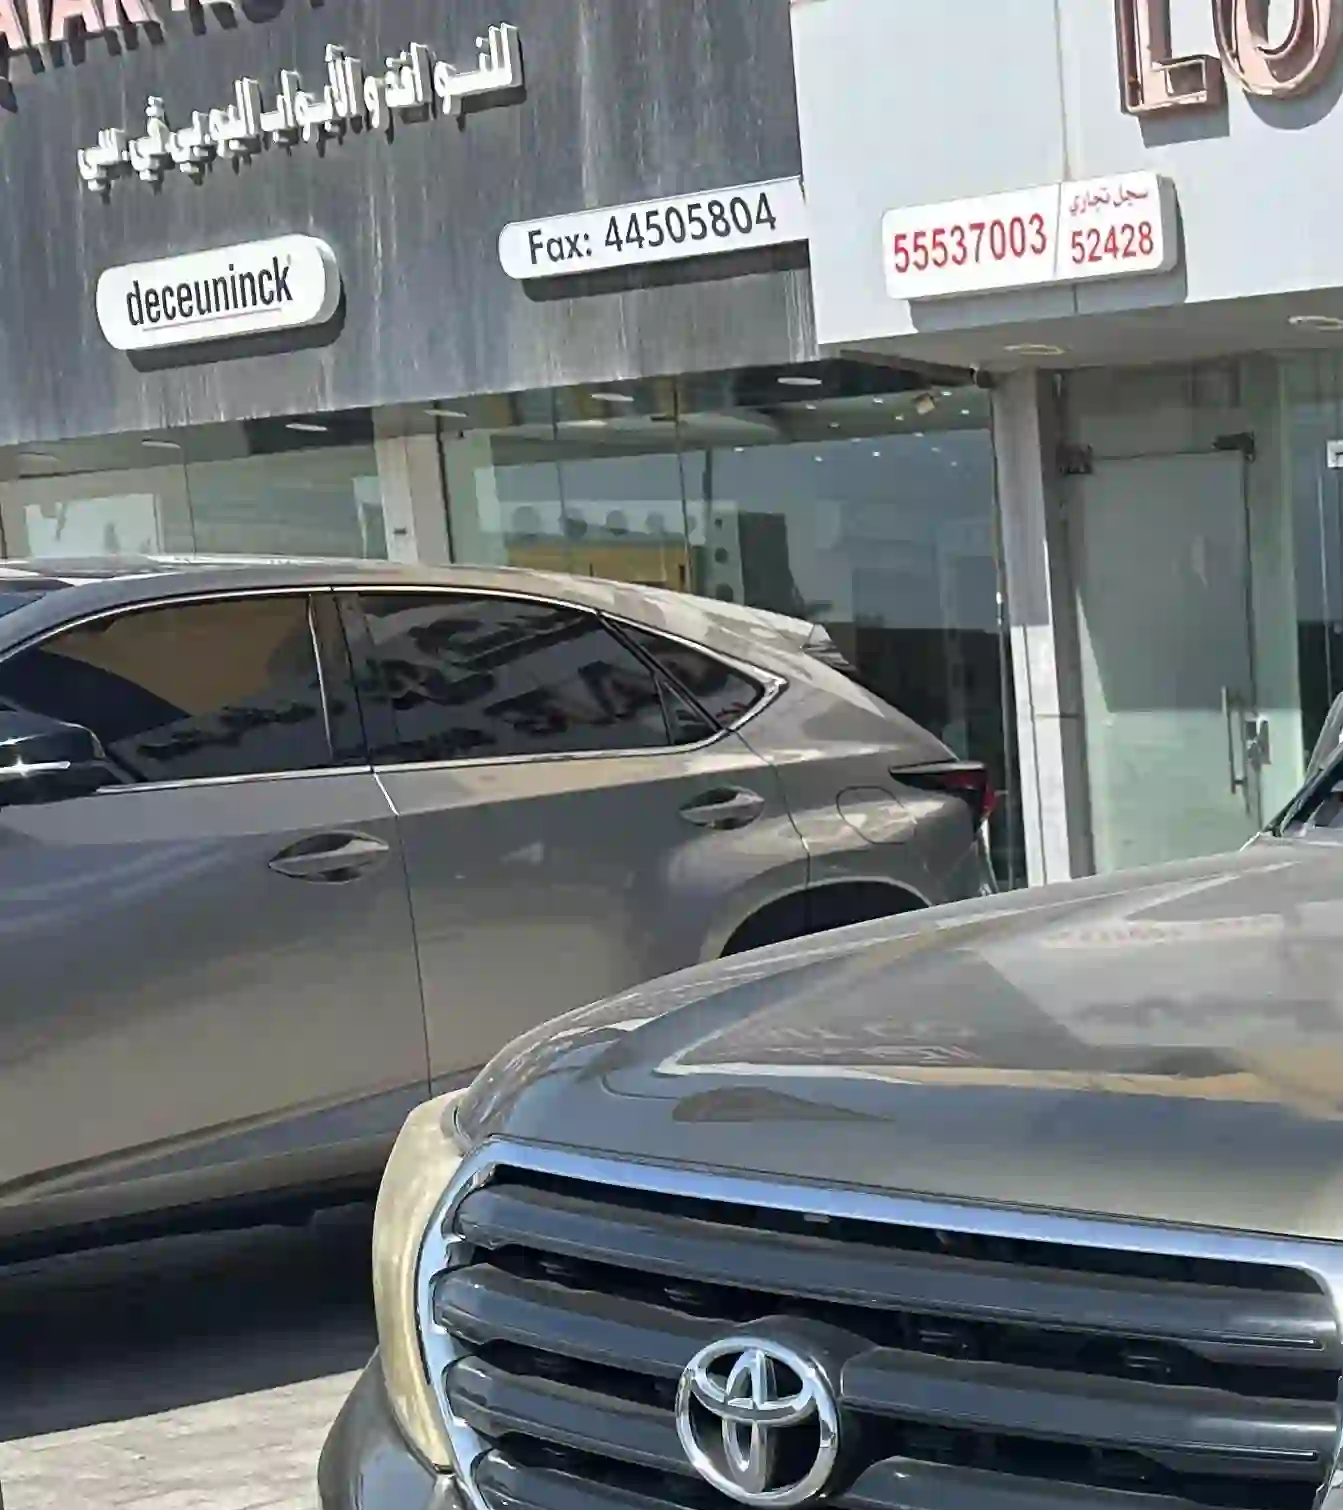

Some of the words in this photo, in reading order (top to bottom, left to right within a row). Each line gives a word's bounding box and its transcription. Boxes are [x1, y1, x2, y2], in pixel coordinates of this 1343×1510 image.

[528, 229, 592, 265] Fax:
[604, 192, 777, 252] 44505804
[894, 213, 1048, 273] 55537003
[1071, 221, 1154, 264] 52428
[126, 256, 293, 326] deceuninck
